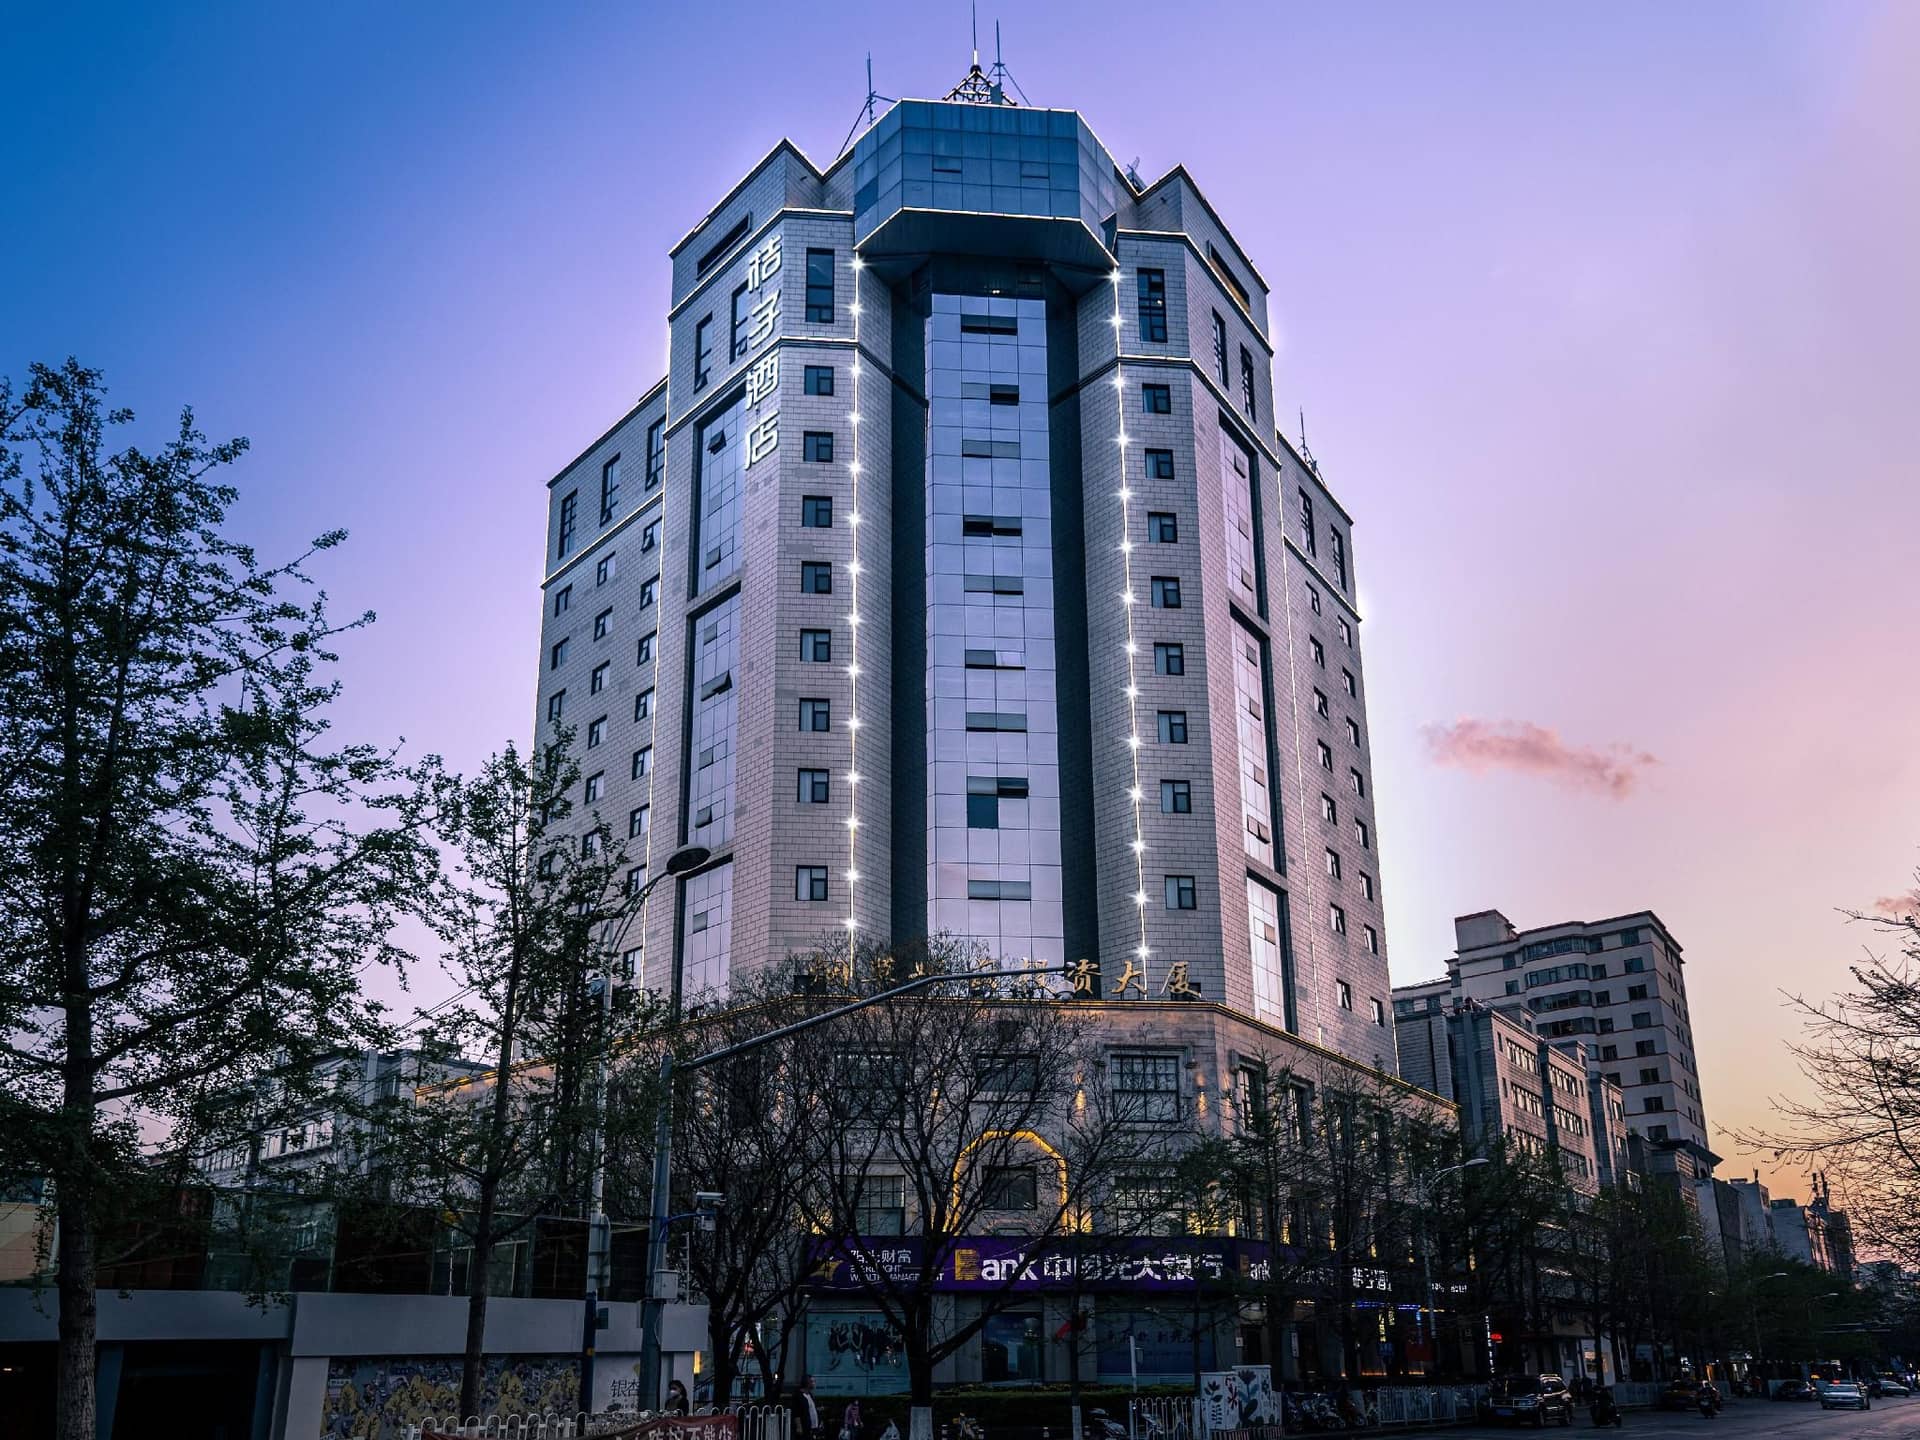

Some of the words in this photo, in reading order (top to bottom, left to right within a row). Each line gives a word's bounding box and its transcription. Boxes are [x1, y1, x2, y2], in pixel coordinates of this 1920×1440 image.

[744, 234, 782, 470] 桔子酒店
[954, 1248, 1039, 1281] Bank
[1043, 1252, 1223, 1281] 中国光大银行
